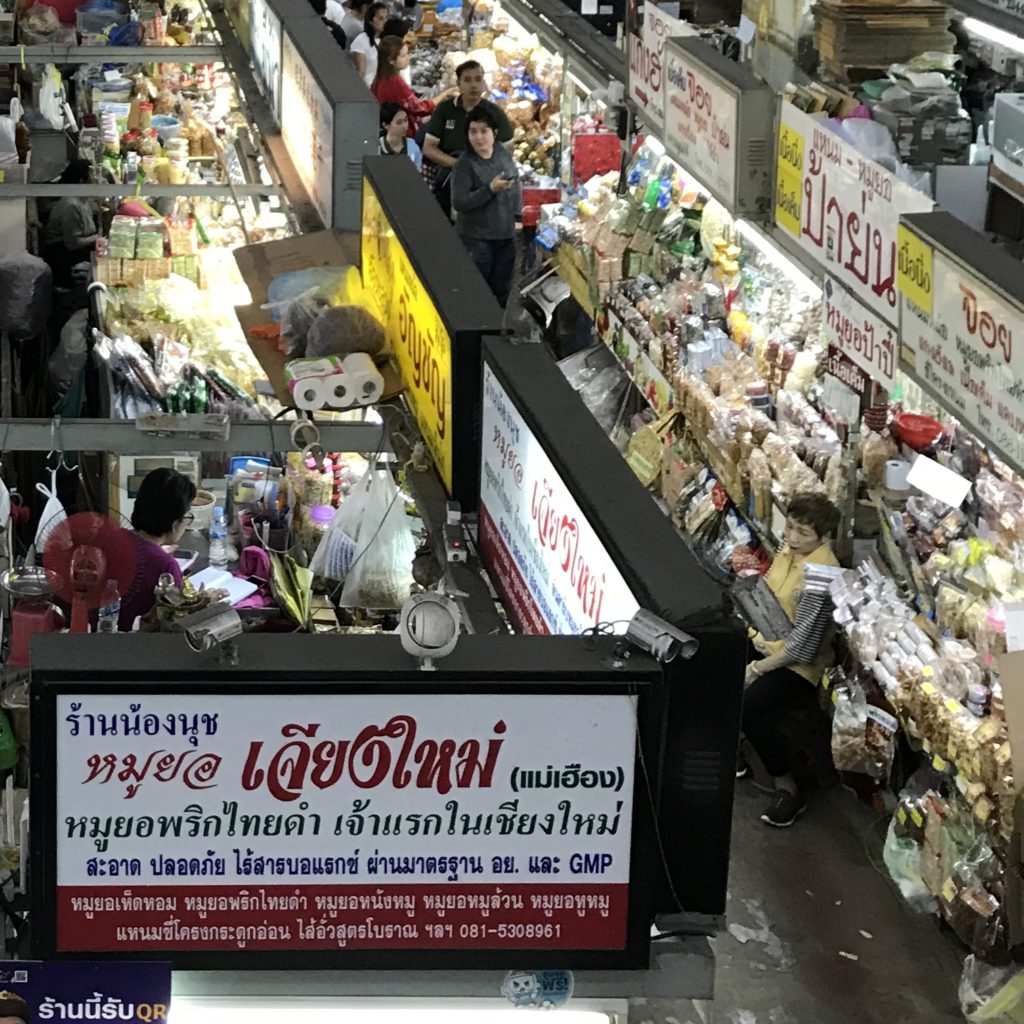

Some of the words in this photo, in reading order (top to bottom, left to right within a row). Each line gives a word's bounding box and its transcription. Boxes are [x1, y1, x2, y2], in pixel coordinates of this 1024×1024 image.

[65, 704, 219, 747] ร้านน้องนุช
[81, 749, 223, 800] หมูยอ
[509, 762, 626, 794] (แม่เฮือง)
[64, 800, 322, 853] หมูยอพริกไทยดำ
[333, 798, 621, 837] เจ้าแรกในเชียงใหม่
[85, 853, 142, 878] สะอาด
[149, 848, 227, 877] ปลอดภัย
[234, 848, 361, 877] ไร้สารบอแรกซ์
[366, 849, 484, 883] ผ่านมาตรฐาน
[490, 853, 520, 876] อย.
[528, 853, 561, 876] และ
[568, 852, 614, 876] GMP
[70, 892, 178, 919] หมูยอเห็ดหอม
[183, 892, 308, 918] หมูยอพริกไทยดำ
[313, 892, 417, 917] หมูยอหนังหมู
[422, 892, 525, 917] หมูยอหมูล้วน
[529, 892, 611, 917] หมูยอหูหมู
[115, 918, 292, 949] แหนมซี่โครงกระดูกอ่อน
[296, 917, 419, 948] ไส้อั่วสูตรโบราณ
[423, 922, 454, 942] ฯลฯ
[459, 922, 563, 942] 081-5308961
[38, 991, 135, 1020] ร้านนี้รับ
[136, 1002, 168, 1024] QR
